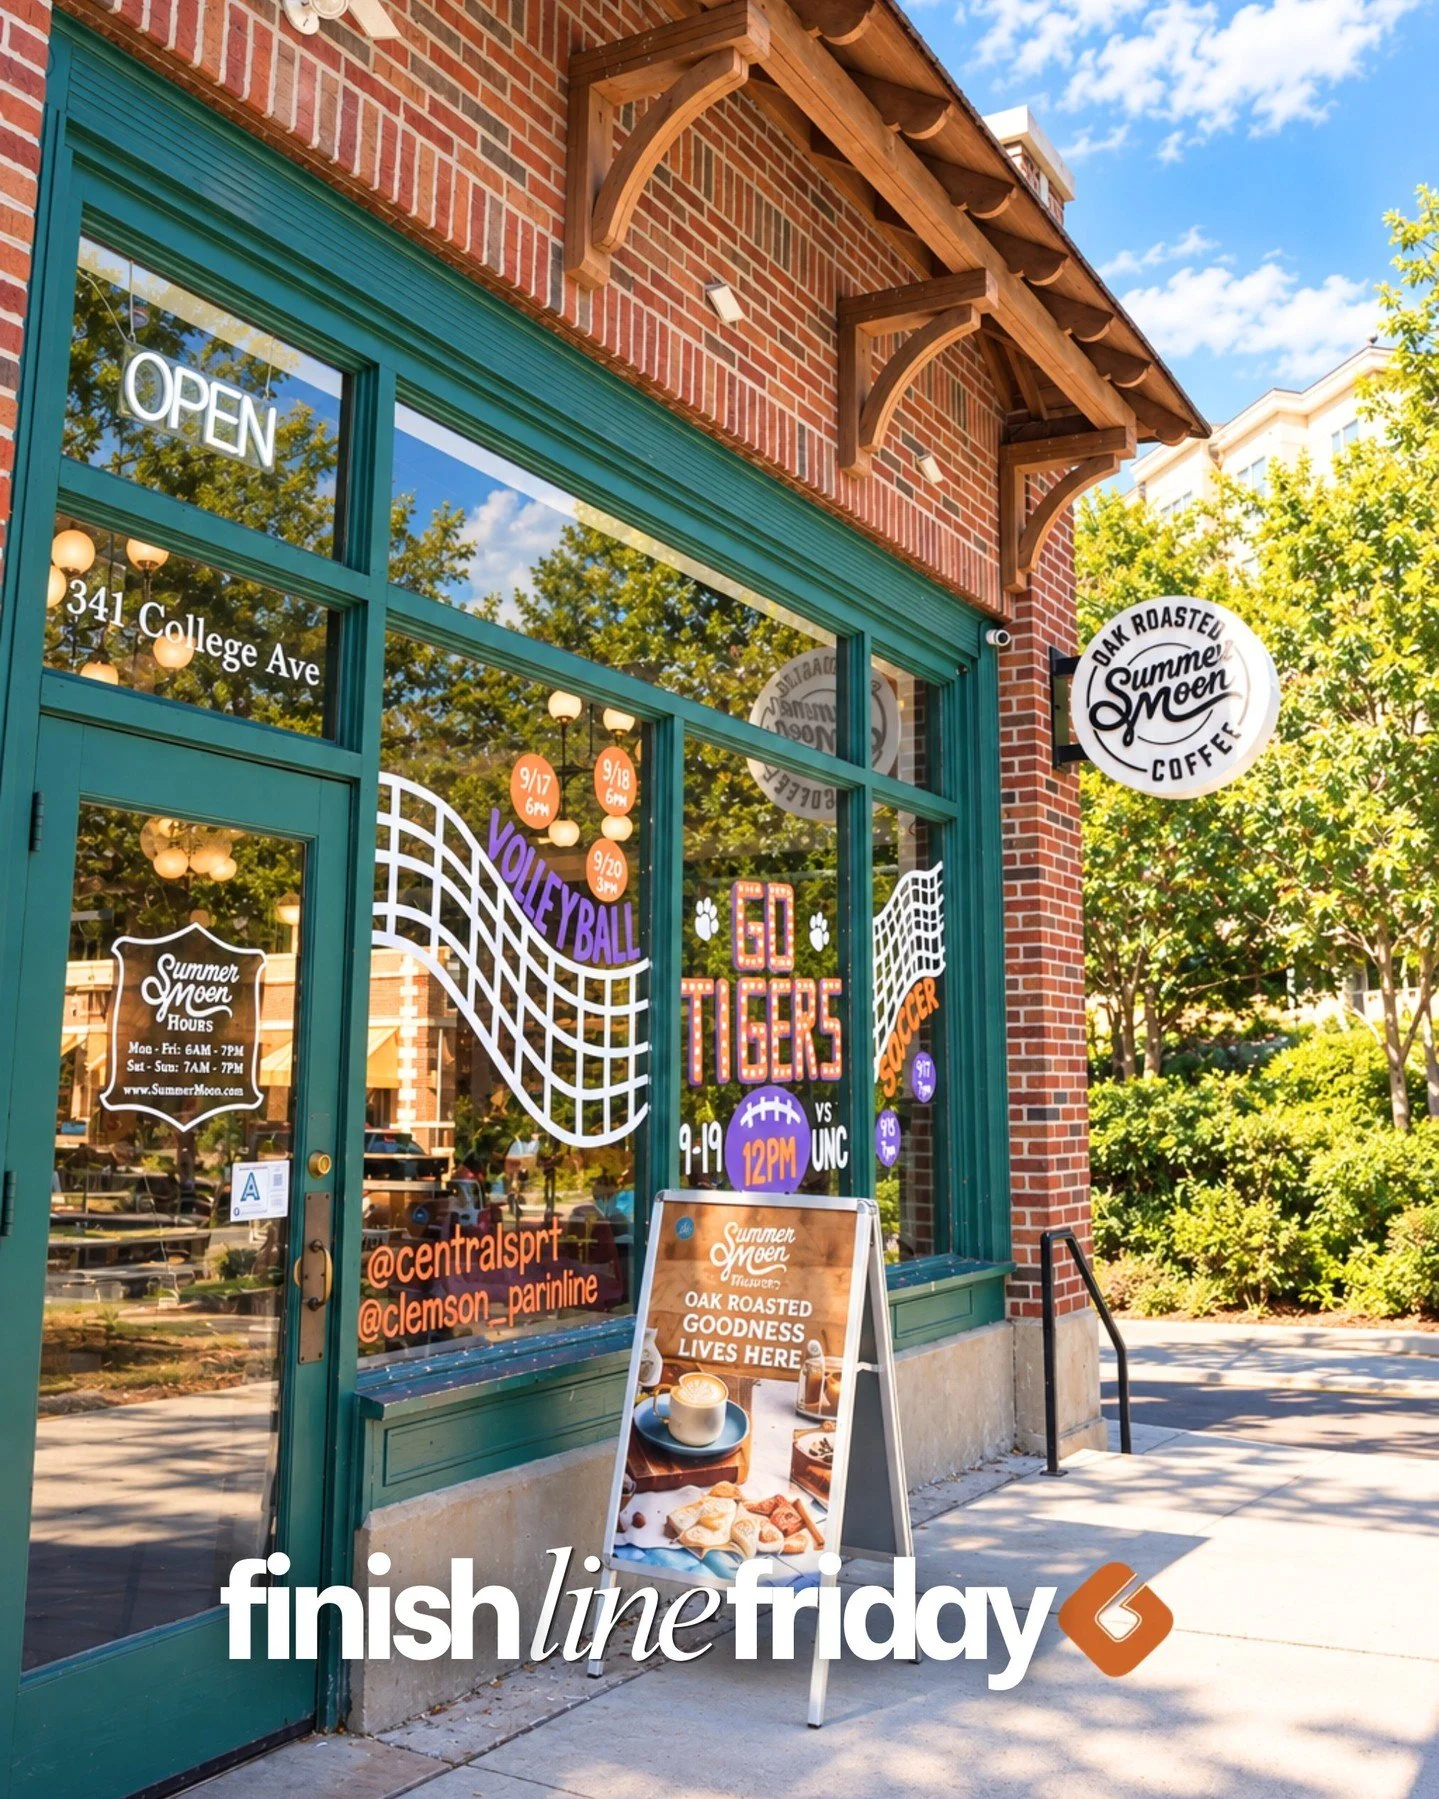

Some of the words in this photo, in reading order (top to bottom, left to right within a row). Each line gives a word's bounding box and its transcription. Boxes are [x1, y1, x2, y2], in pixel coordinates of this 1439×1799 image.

[124, 351, 278, 469] OPEN
[66, 579, 126, 629] 341
[138, 601, 258, 673] College
[265, 643, 321, 687] Ave
[1091, 624, 1131, 667] OAK
[1130, 606, 1227, 642] ROASTED
[602, 758, 631, 790] 9/18
[1152, 722, 1242, 782] COFFEE
[519, 766, 551, 796] 9/17
[605, 788, 628, 807] 6PM
[525, 797, 550, 817] 6PM
[487, 807, 641, 965] VOLLEYBALL
[593, 850, 622, 878] 9/20
[595, 876, 618, 894] 3PM
[731, 880, 795, 973] GO
[141, 953, 240, 1005] Summer
[185, 1044, 212, 1056] 6AM
[221, 1045, 244, 1057] 7PM
[680, 976, 843, 1086] TIGERS
[879, 976, 940, 1098] SOCCER
[184, 1061, 210, 1073] 7AM
[221, 1062, 244, 1074] 7PM
[679, 1121, 723, 1176] 9-19
[742, 1135, 797, 1187] 12PM
[811, 1125, 849, 1172] UNC
[239, 1171, 260, 1202] A
[367, 1216, 563, 1289] @centralsprt
[710, 1221, 797, 1267] Summer
[685, 1291, 722, 1310] OAK
[727, 1294, 813, 1318] ROASTED
[683, 1313, 805, 1343] GOODNESS
[677, 1338, 738, 1363] LIVES
[743, 1345, 803, 1370] HERE
